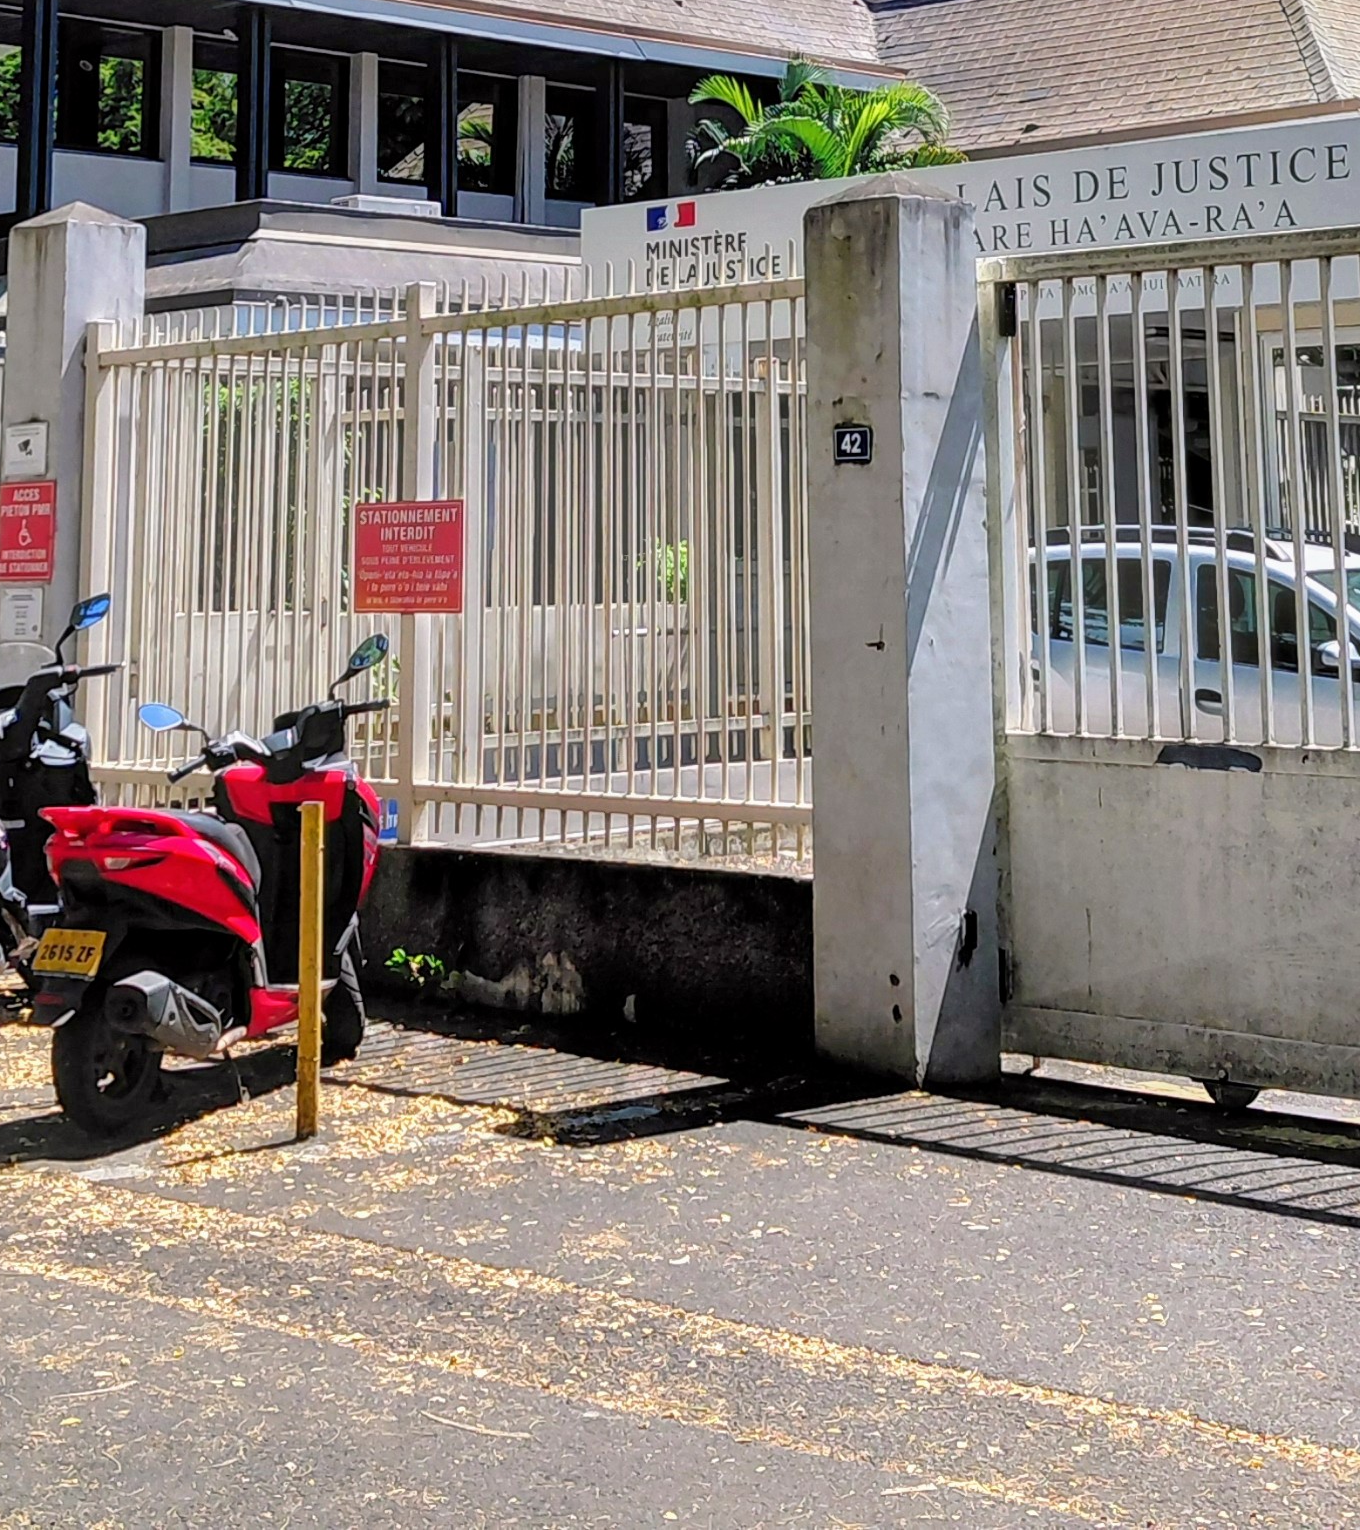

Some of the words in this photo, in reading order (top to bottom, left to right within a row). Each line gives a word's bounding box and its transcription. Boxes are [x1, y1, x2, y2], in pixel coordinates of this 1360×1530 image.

[1073, 166, 1130, 204] DE
[1151, 144, 1350, 196] JUSTICE
[1049, 199, 1298, 246] HA’AVA-RA’A
[646, 230, 747, 261] MINISTÈRE
[840, 432, 862, 454] 42
[360, 508, 458, 525] STATIONNEMENT
[380, 526, 435, 541] INTERDIT
[40, 944, 75, 961] 2615
[76, 945, 96, 963] ZF
